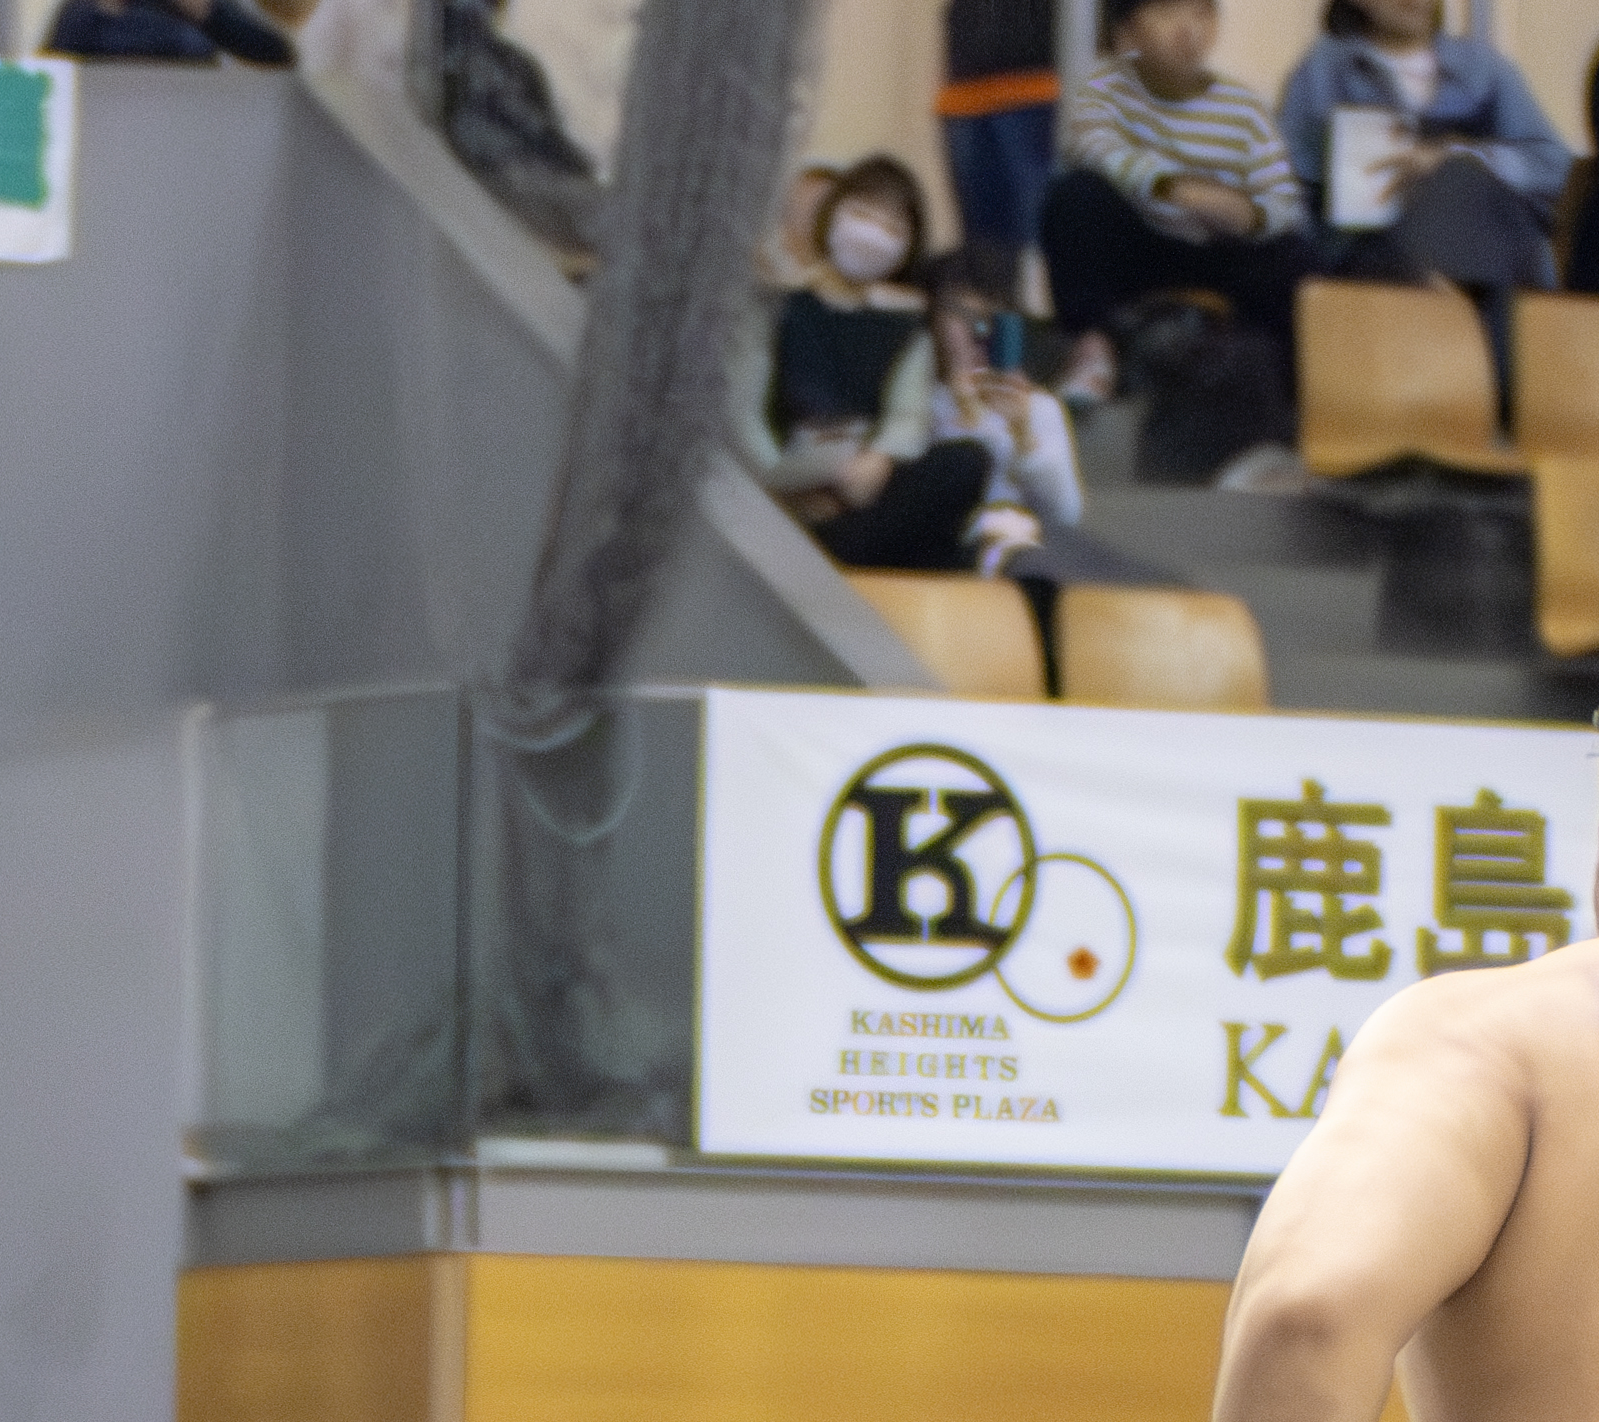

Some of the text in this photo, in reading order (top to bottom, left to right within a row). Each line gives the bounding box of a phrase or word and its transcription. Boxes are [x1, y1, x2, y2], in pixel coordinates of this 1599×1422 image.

[850, 1009, 1011, 1041] KASHIMA
[838, 1049, 1019, 1083] HEIGHTS
[809, 1088, 1060, 1122] SPORTS PLAZA
